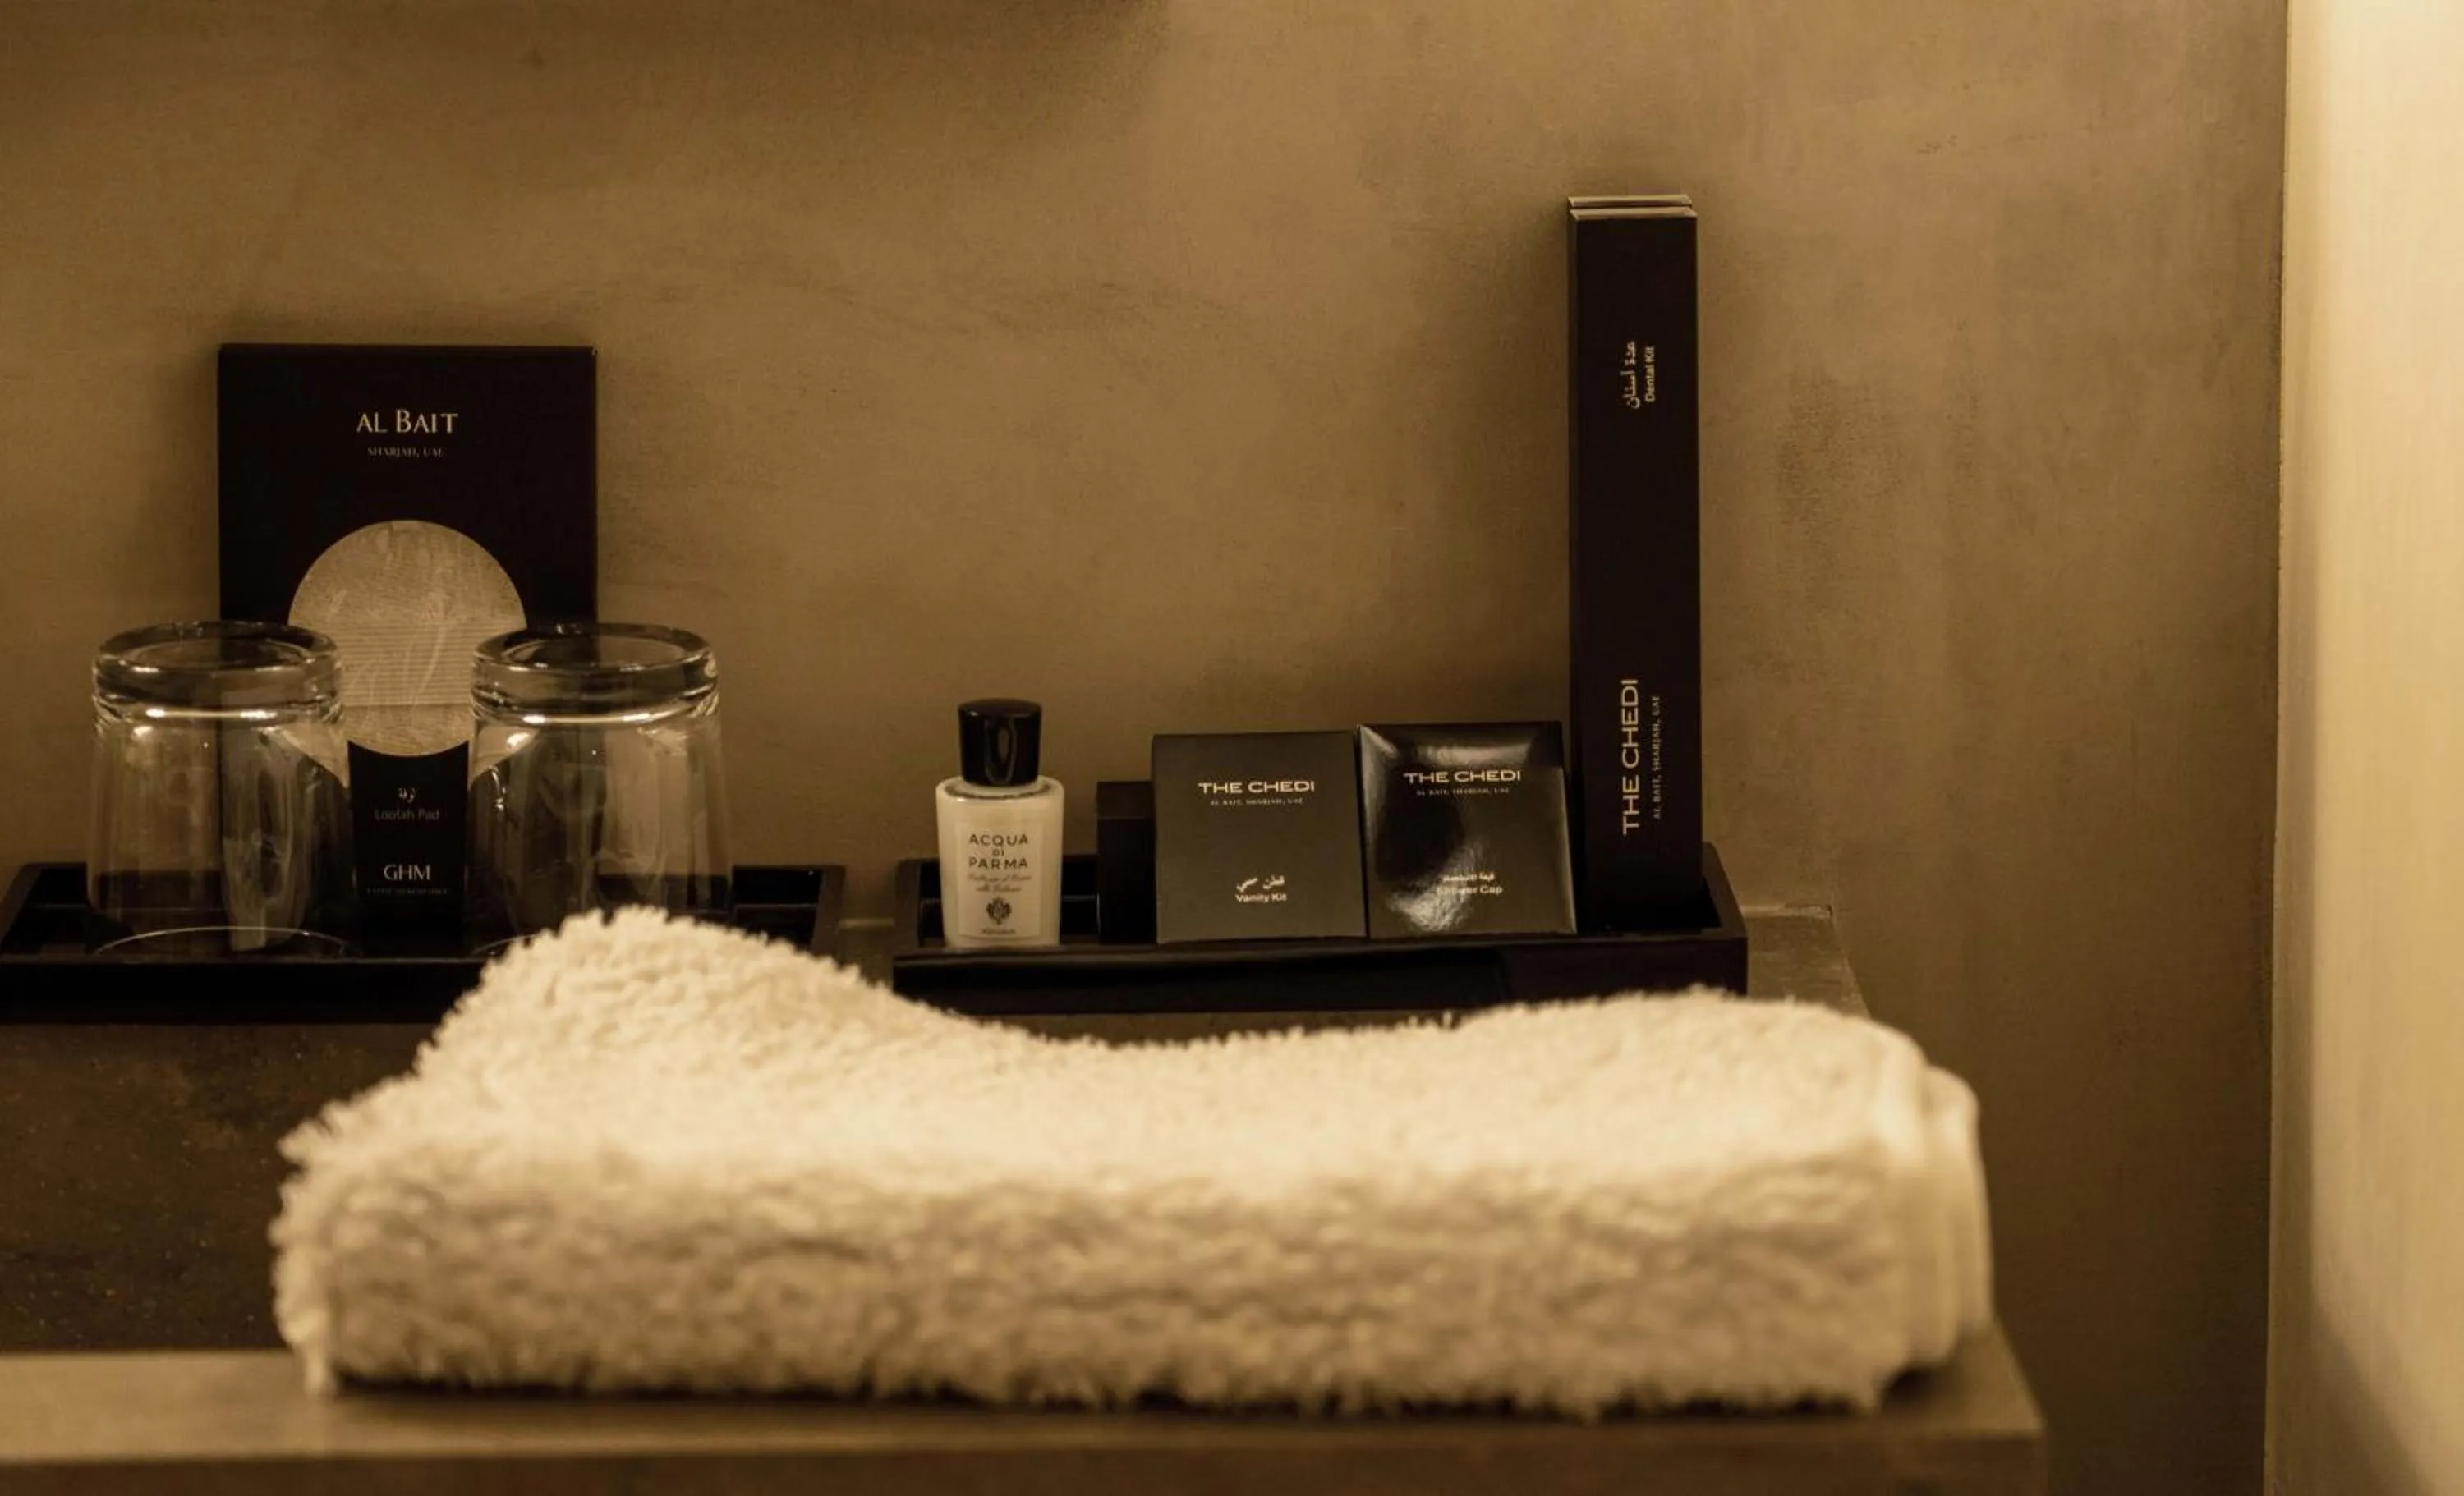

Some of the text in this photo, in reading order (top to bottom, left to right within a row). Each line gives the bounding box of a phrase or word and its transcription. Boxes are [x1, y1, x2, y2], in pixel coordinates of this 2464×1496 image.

[1645, 346, 1655, 402] Dental Kit
[356, 408, 459, 434] AL BAIT
[1620, 679, 1640, 836] THE CHEDI
[1403, 769, 1522, 785] THE CHEDI
[1198, 780, 1316, 795] THE CHEDI
[968, 833, 1029, 847] ACQUA
[991, 848, 1005, 856] DI
[968, 856, 1028, 870] PARMA
[383, 864, 431, 881] GHM
[1479, 884, 1504, 896] Cap
[1235, 893, 1287, 903] Vanity Kit
